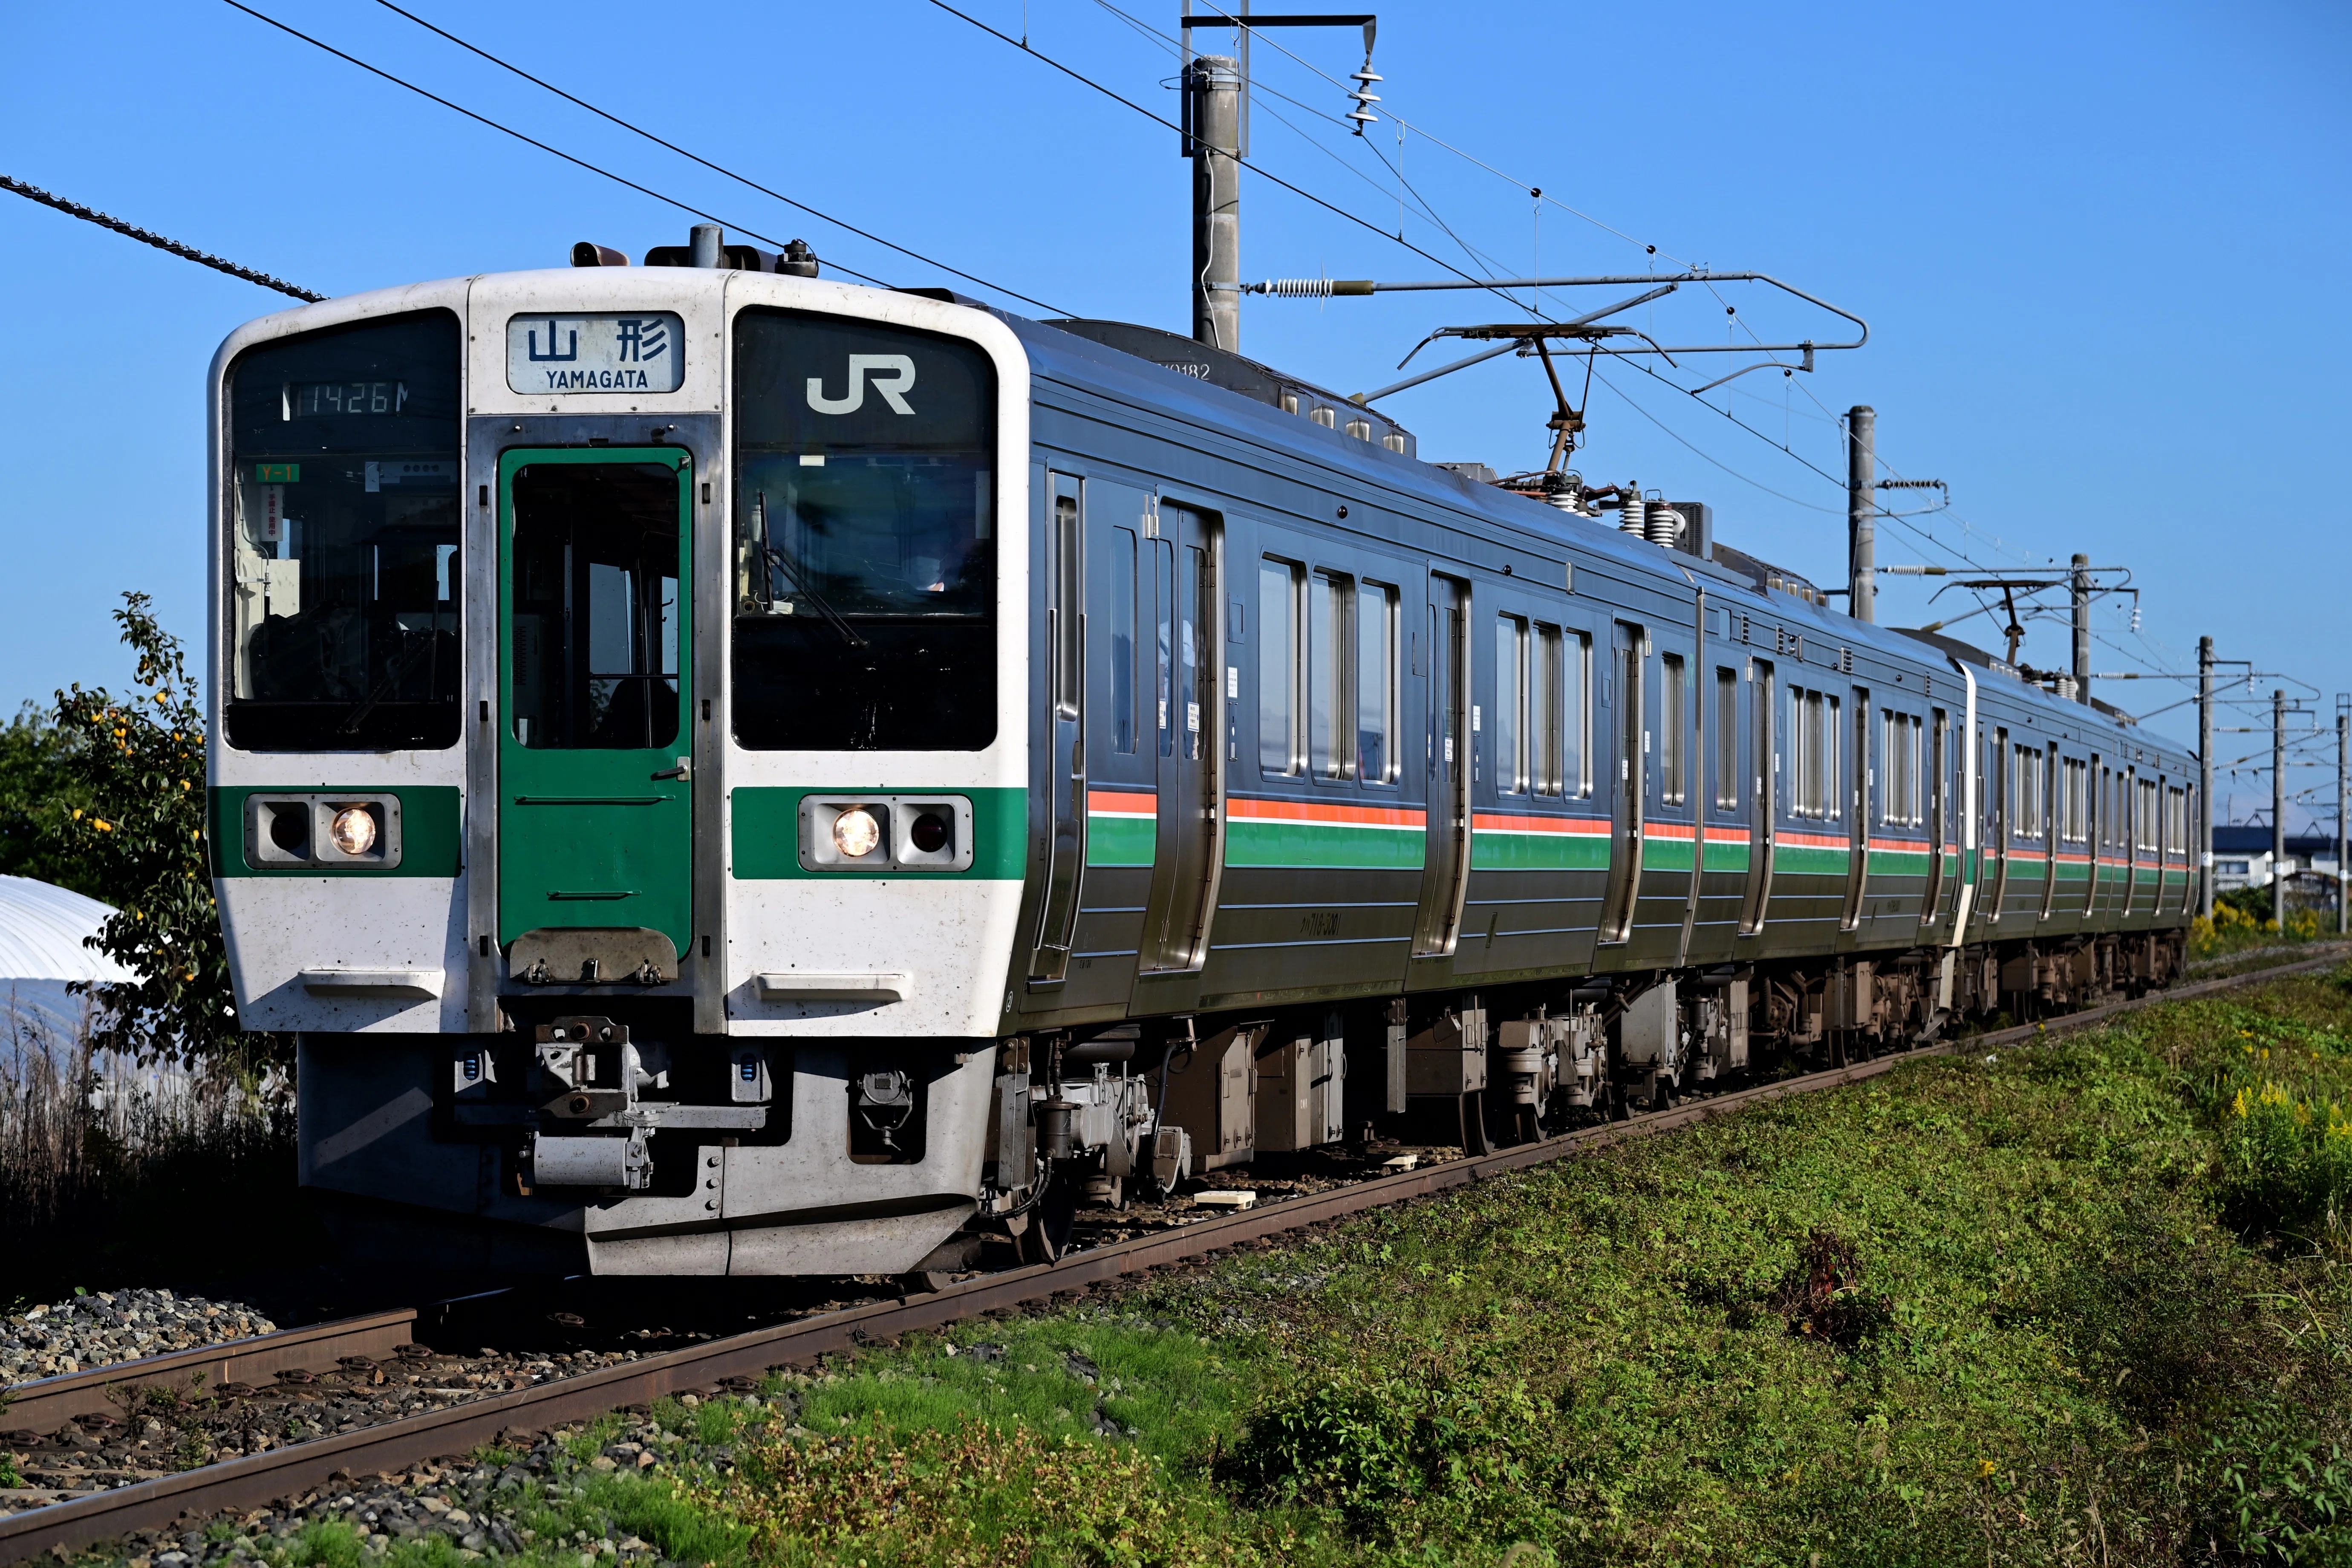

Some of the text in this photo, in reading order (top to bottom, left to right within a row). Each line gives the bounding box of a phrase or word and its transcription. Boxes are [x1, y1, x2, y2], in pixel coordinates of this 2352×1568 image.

[528, 318, 667, 362] 山形
[546, 370, 648, 389] YAMAGATA
[806, 354, 916, 415] JR
[262, 465, 291, 481] Y-1
[1686, 653, 1694, 687] JR
